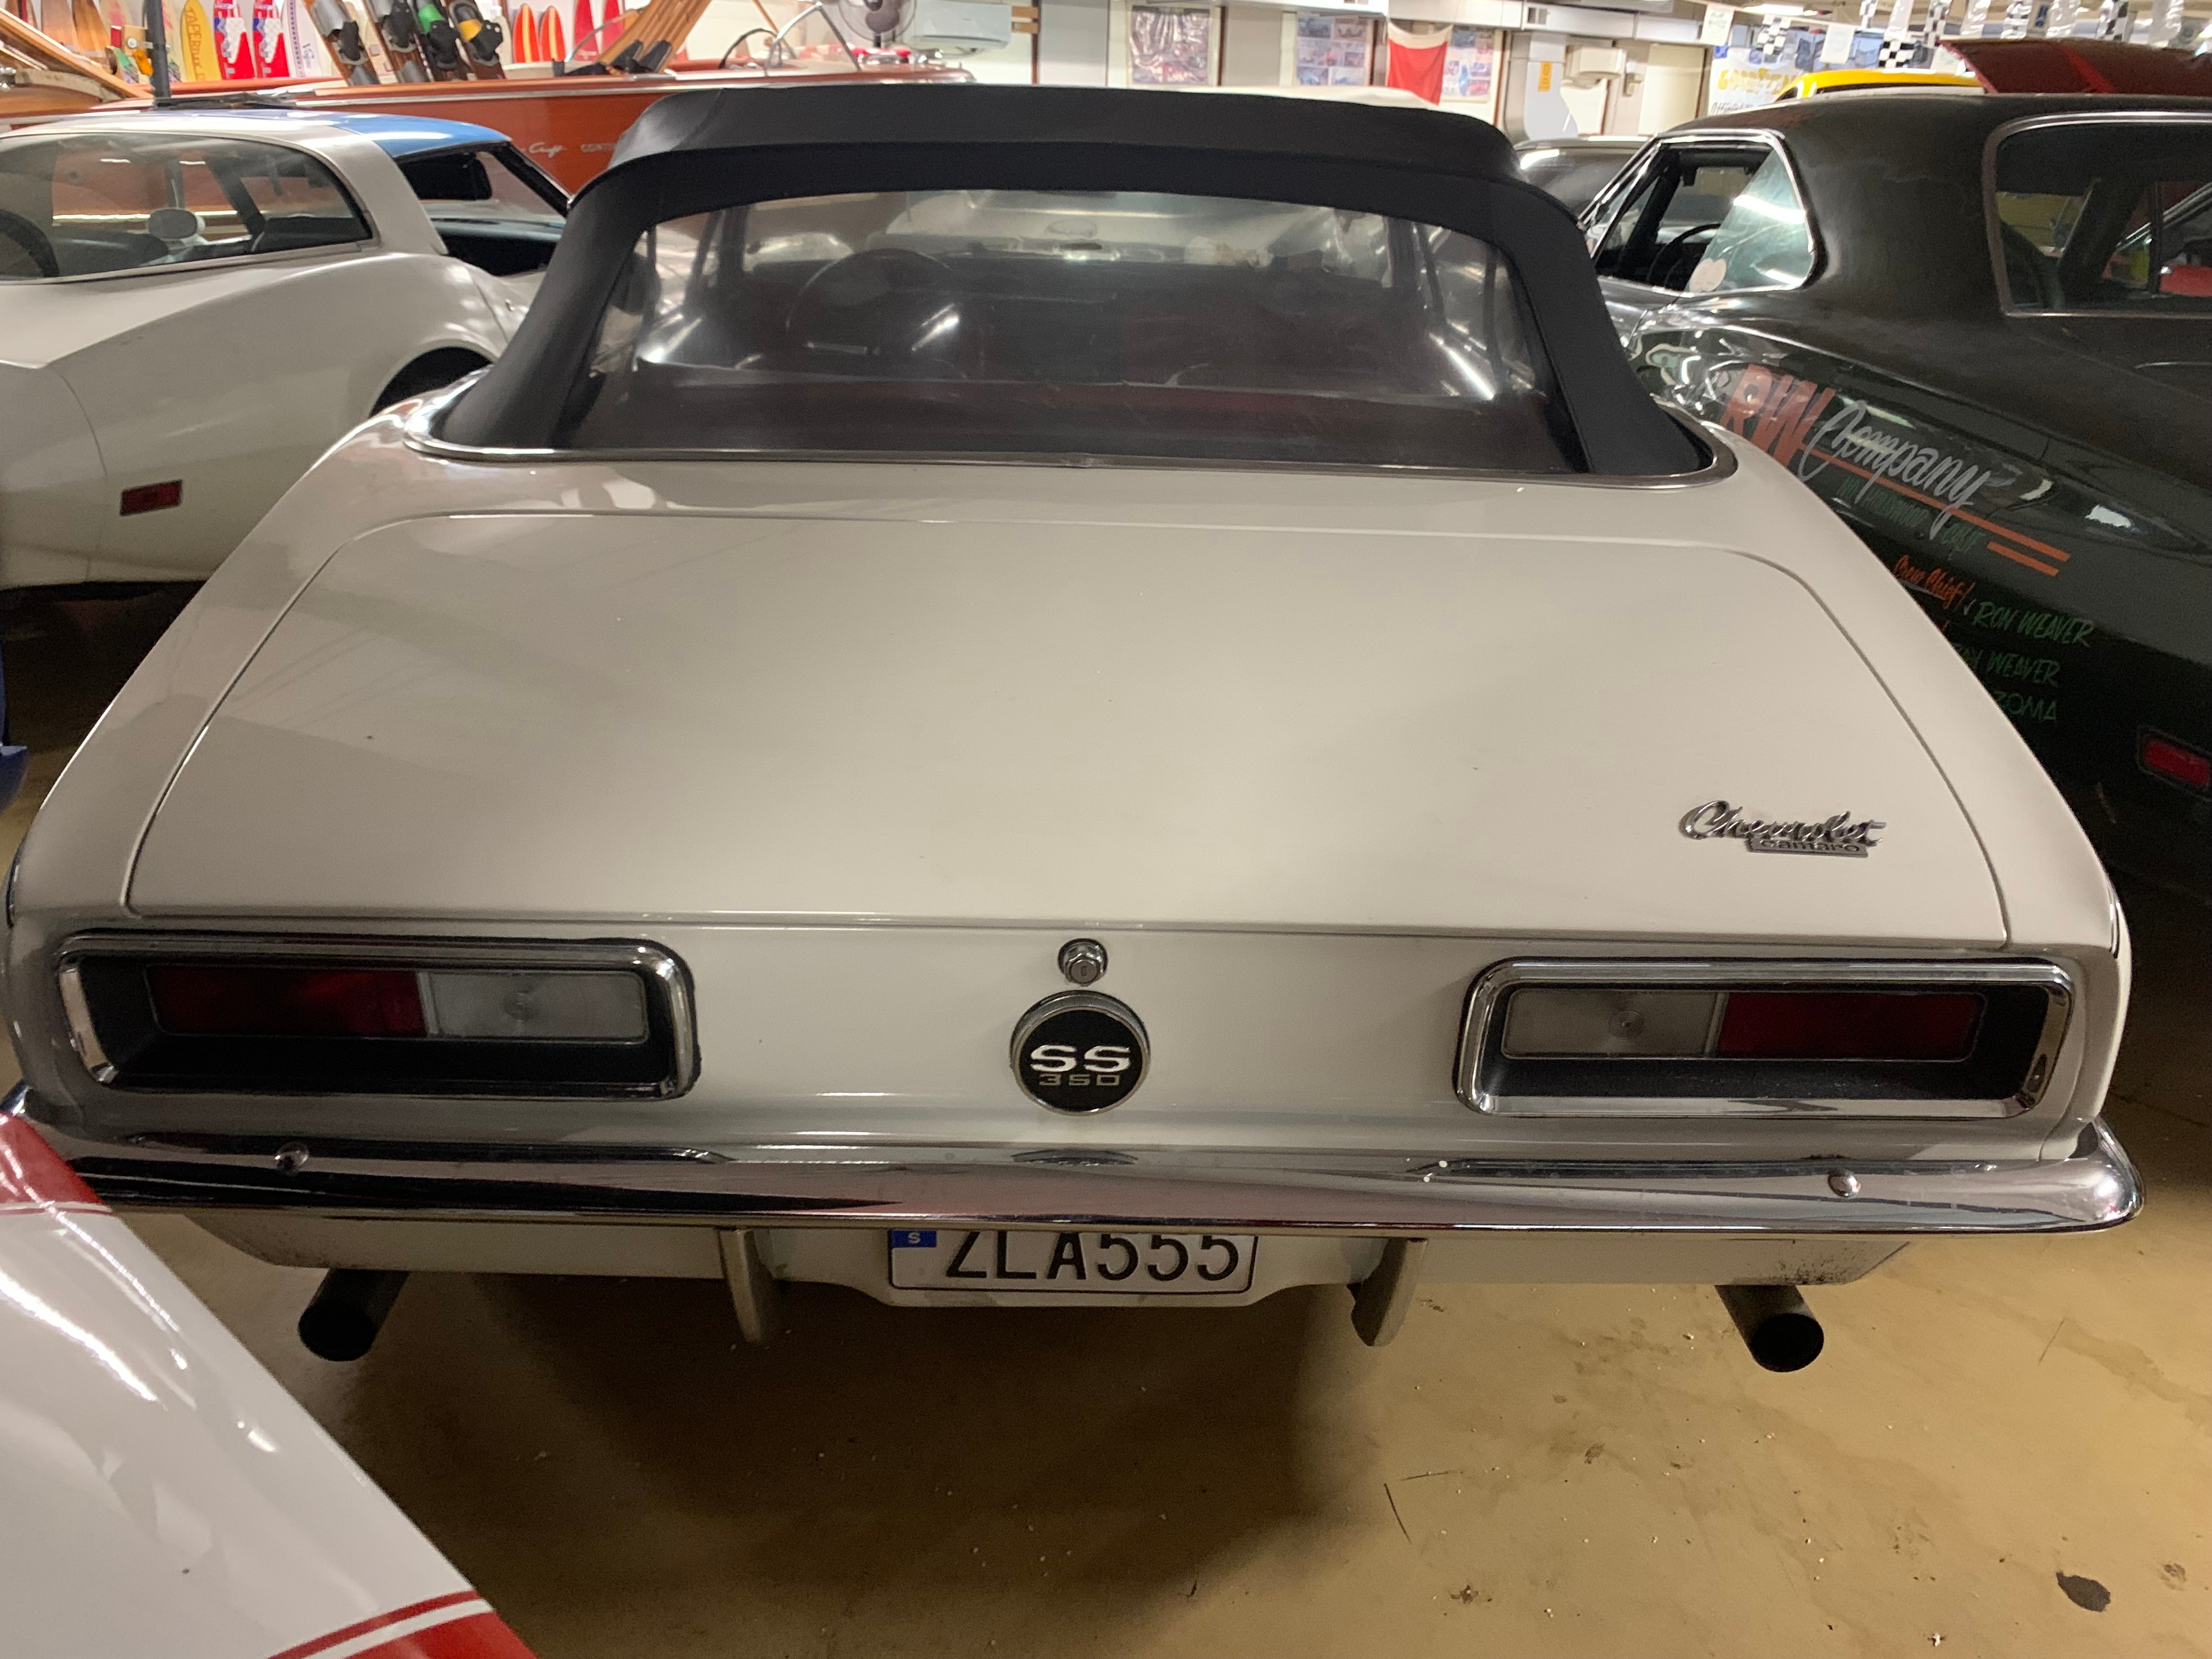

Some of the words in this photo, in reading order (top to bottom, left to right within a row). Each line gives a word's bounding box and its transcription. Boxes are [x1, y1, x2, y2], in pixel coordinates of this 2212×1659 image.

[1798, 399, 1991, 540] Company
[2017, 611, 2095, 648] WEAVER
[1987, 651, 2061, 688] WEAVER
[1678, 800, 1887, 847] Chevrolet
[1030, 1045, 1131, 1073] SS
[1040, 1073, 1120, 1086] 350
[908, 1232, 921, 1245] S
[946, 1231, 1239, 1282] ZLA555
